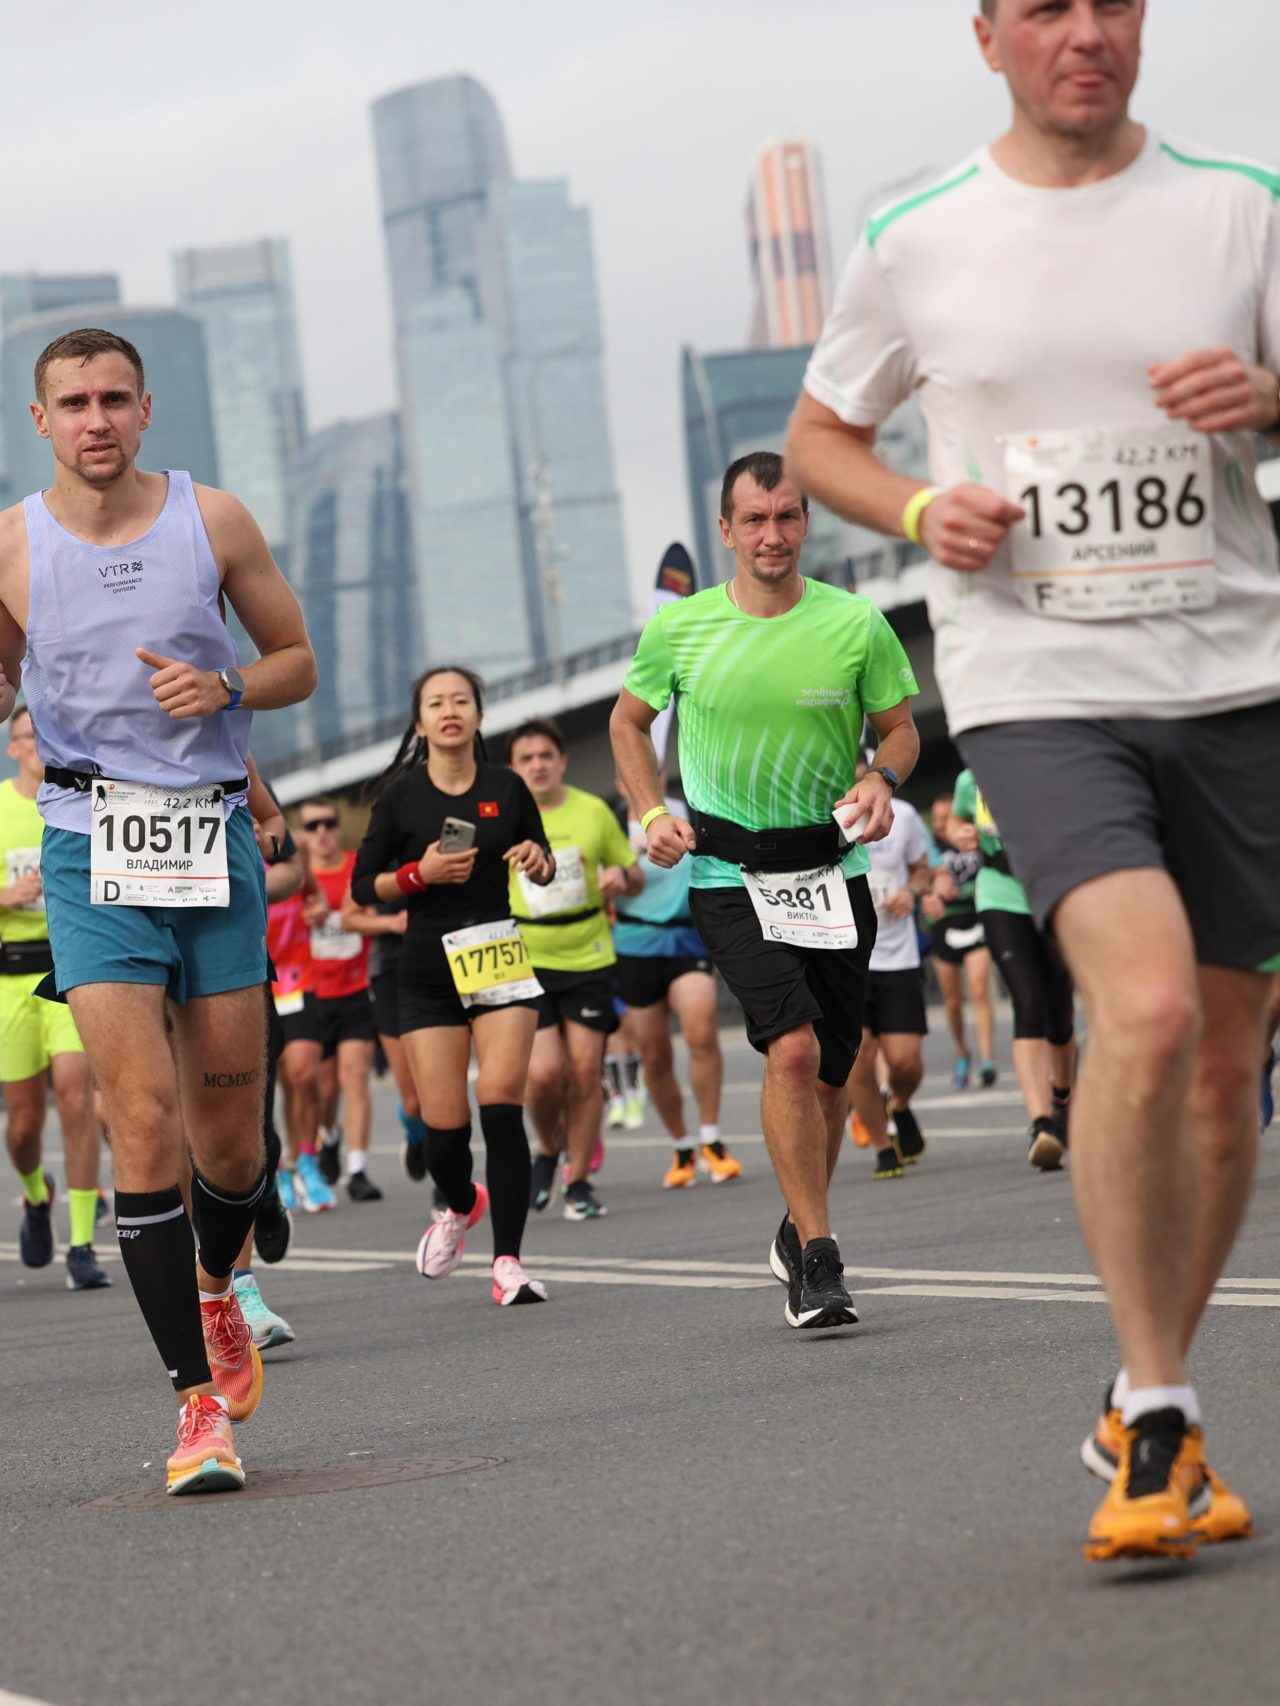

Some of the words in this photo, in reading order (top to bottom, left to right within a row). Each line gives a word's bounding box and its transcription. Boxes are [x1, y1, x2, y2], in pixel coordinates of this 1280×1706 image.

[1020, 471, 1206, 538] 13186
[1072, 540, 1158, 562] АРСЕНИЙ
[98, 563, 130, 578] VTR
[103, 577, 143, 589] PERFORMANCE
[1033, 581, 1055, 609] F
[163, 797, 191, 810] 42,2
[98, 814, 221, 854] 10517
[126, 858, 194, 872] ВЛАДИМИР
[103, 880, 121, 902] D
[757, 883, 832, 912] 5881
[769, 925, 783, 940] G
[454, 940, 525, 978] 17757
